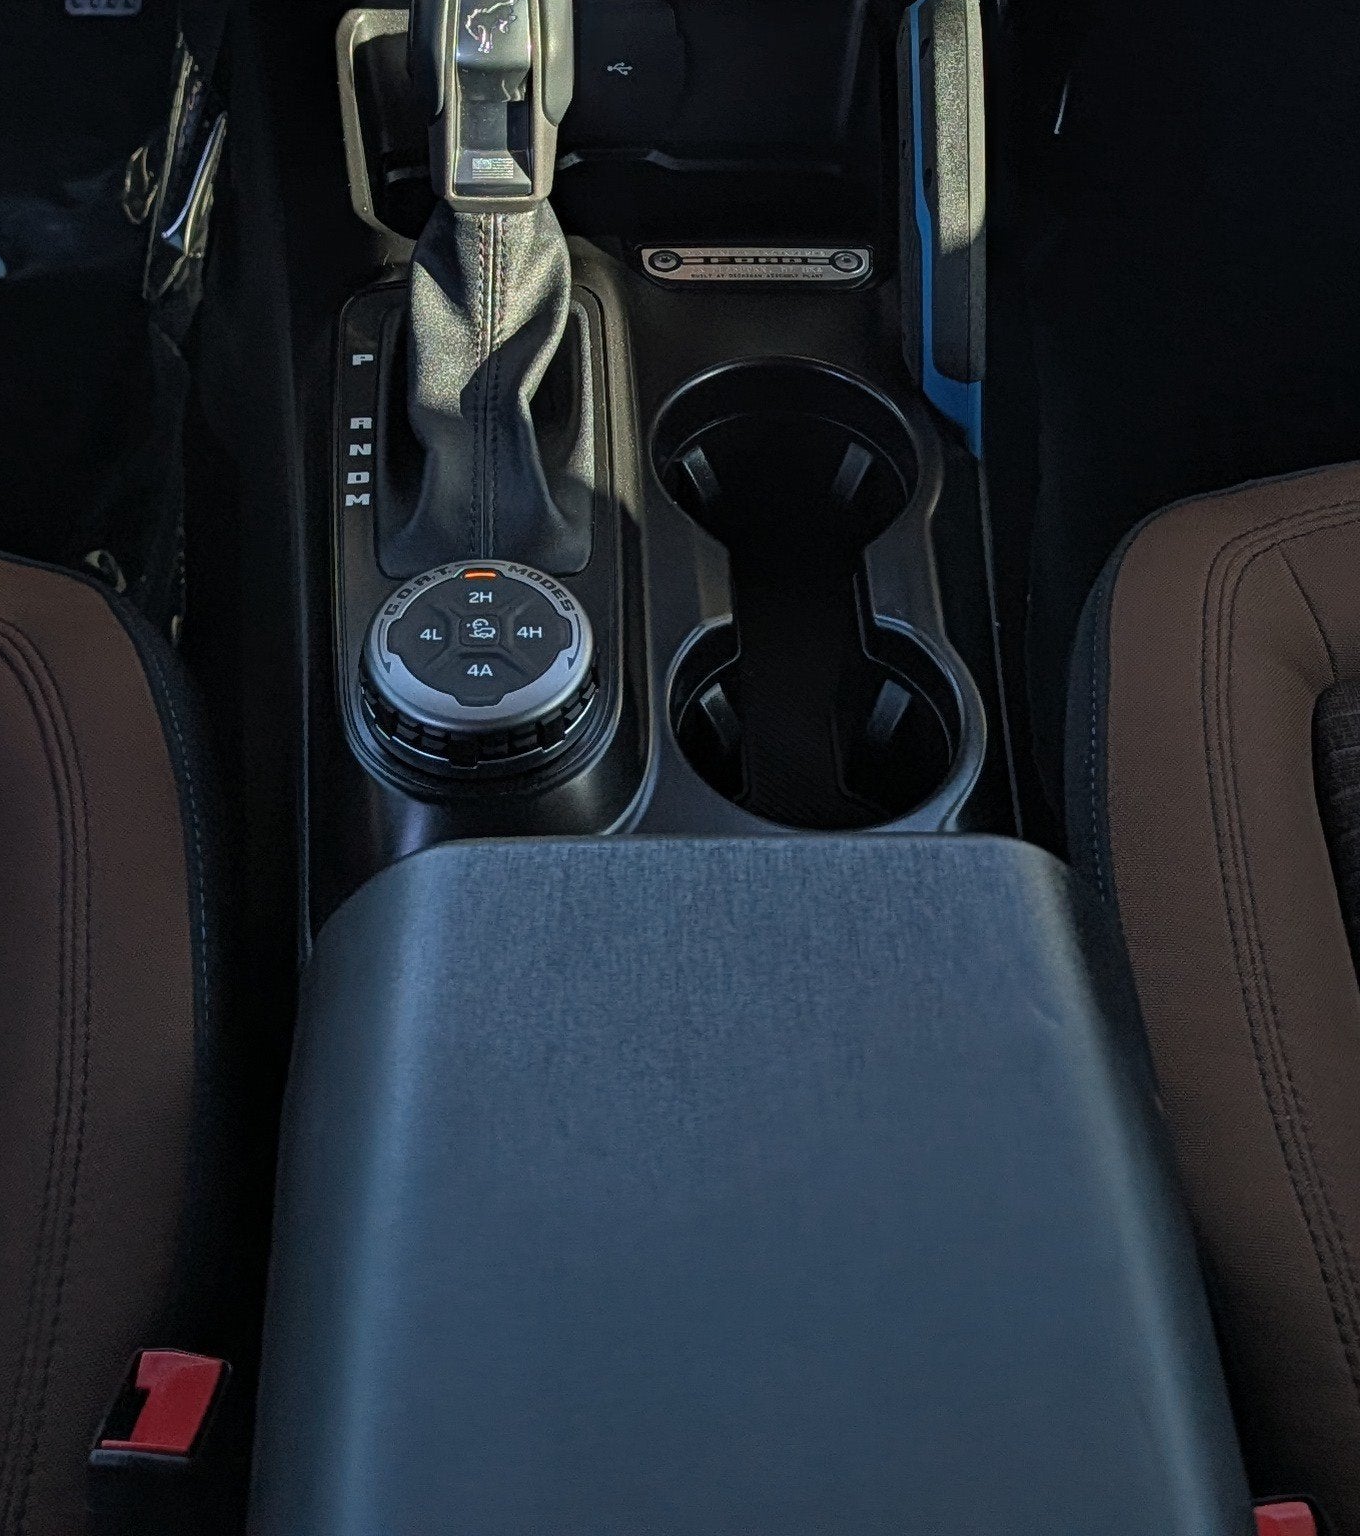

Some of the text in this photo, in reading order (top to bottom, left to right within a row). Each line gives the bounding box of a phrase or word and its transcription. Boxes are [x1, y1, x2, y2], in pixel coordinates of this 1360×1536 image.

[352, 354, 374, 366] P
[349, 443, 372, 456] N
[347, 471, 370, 484] D
[345, 493, 370, 506] M
[507, 564, 576, 612] MODES
[469, 591, 493, 604] 2H
[420, 628, 443, 640] 4L
[516, 627, 542, 639] 4H
[467, 664, 493, 677] 4A
